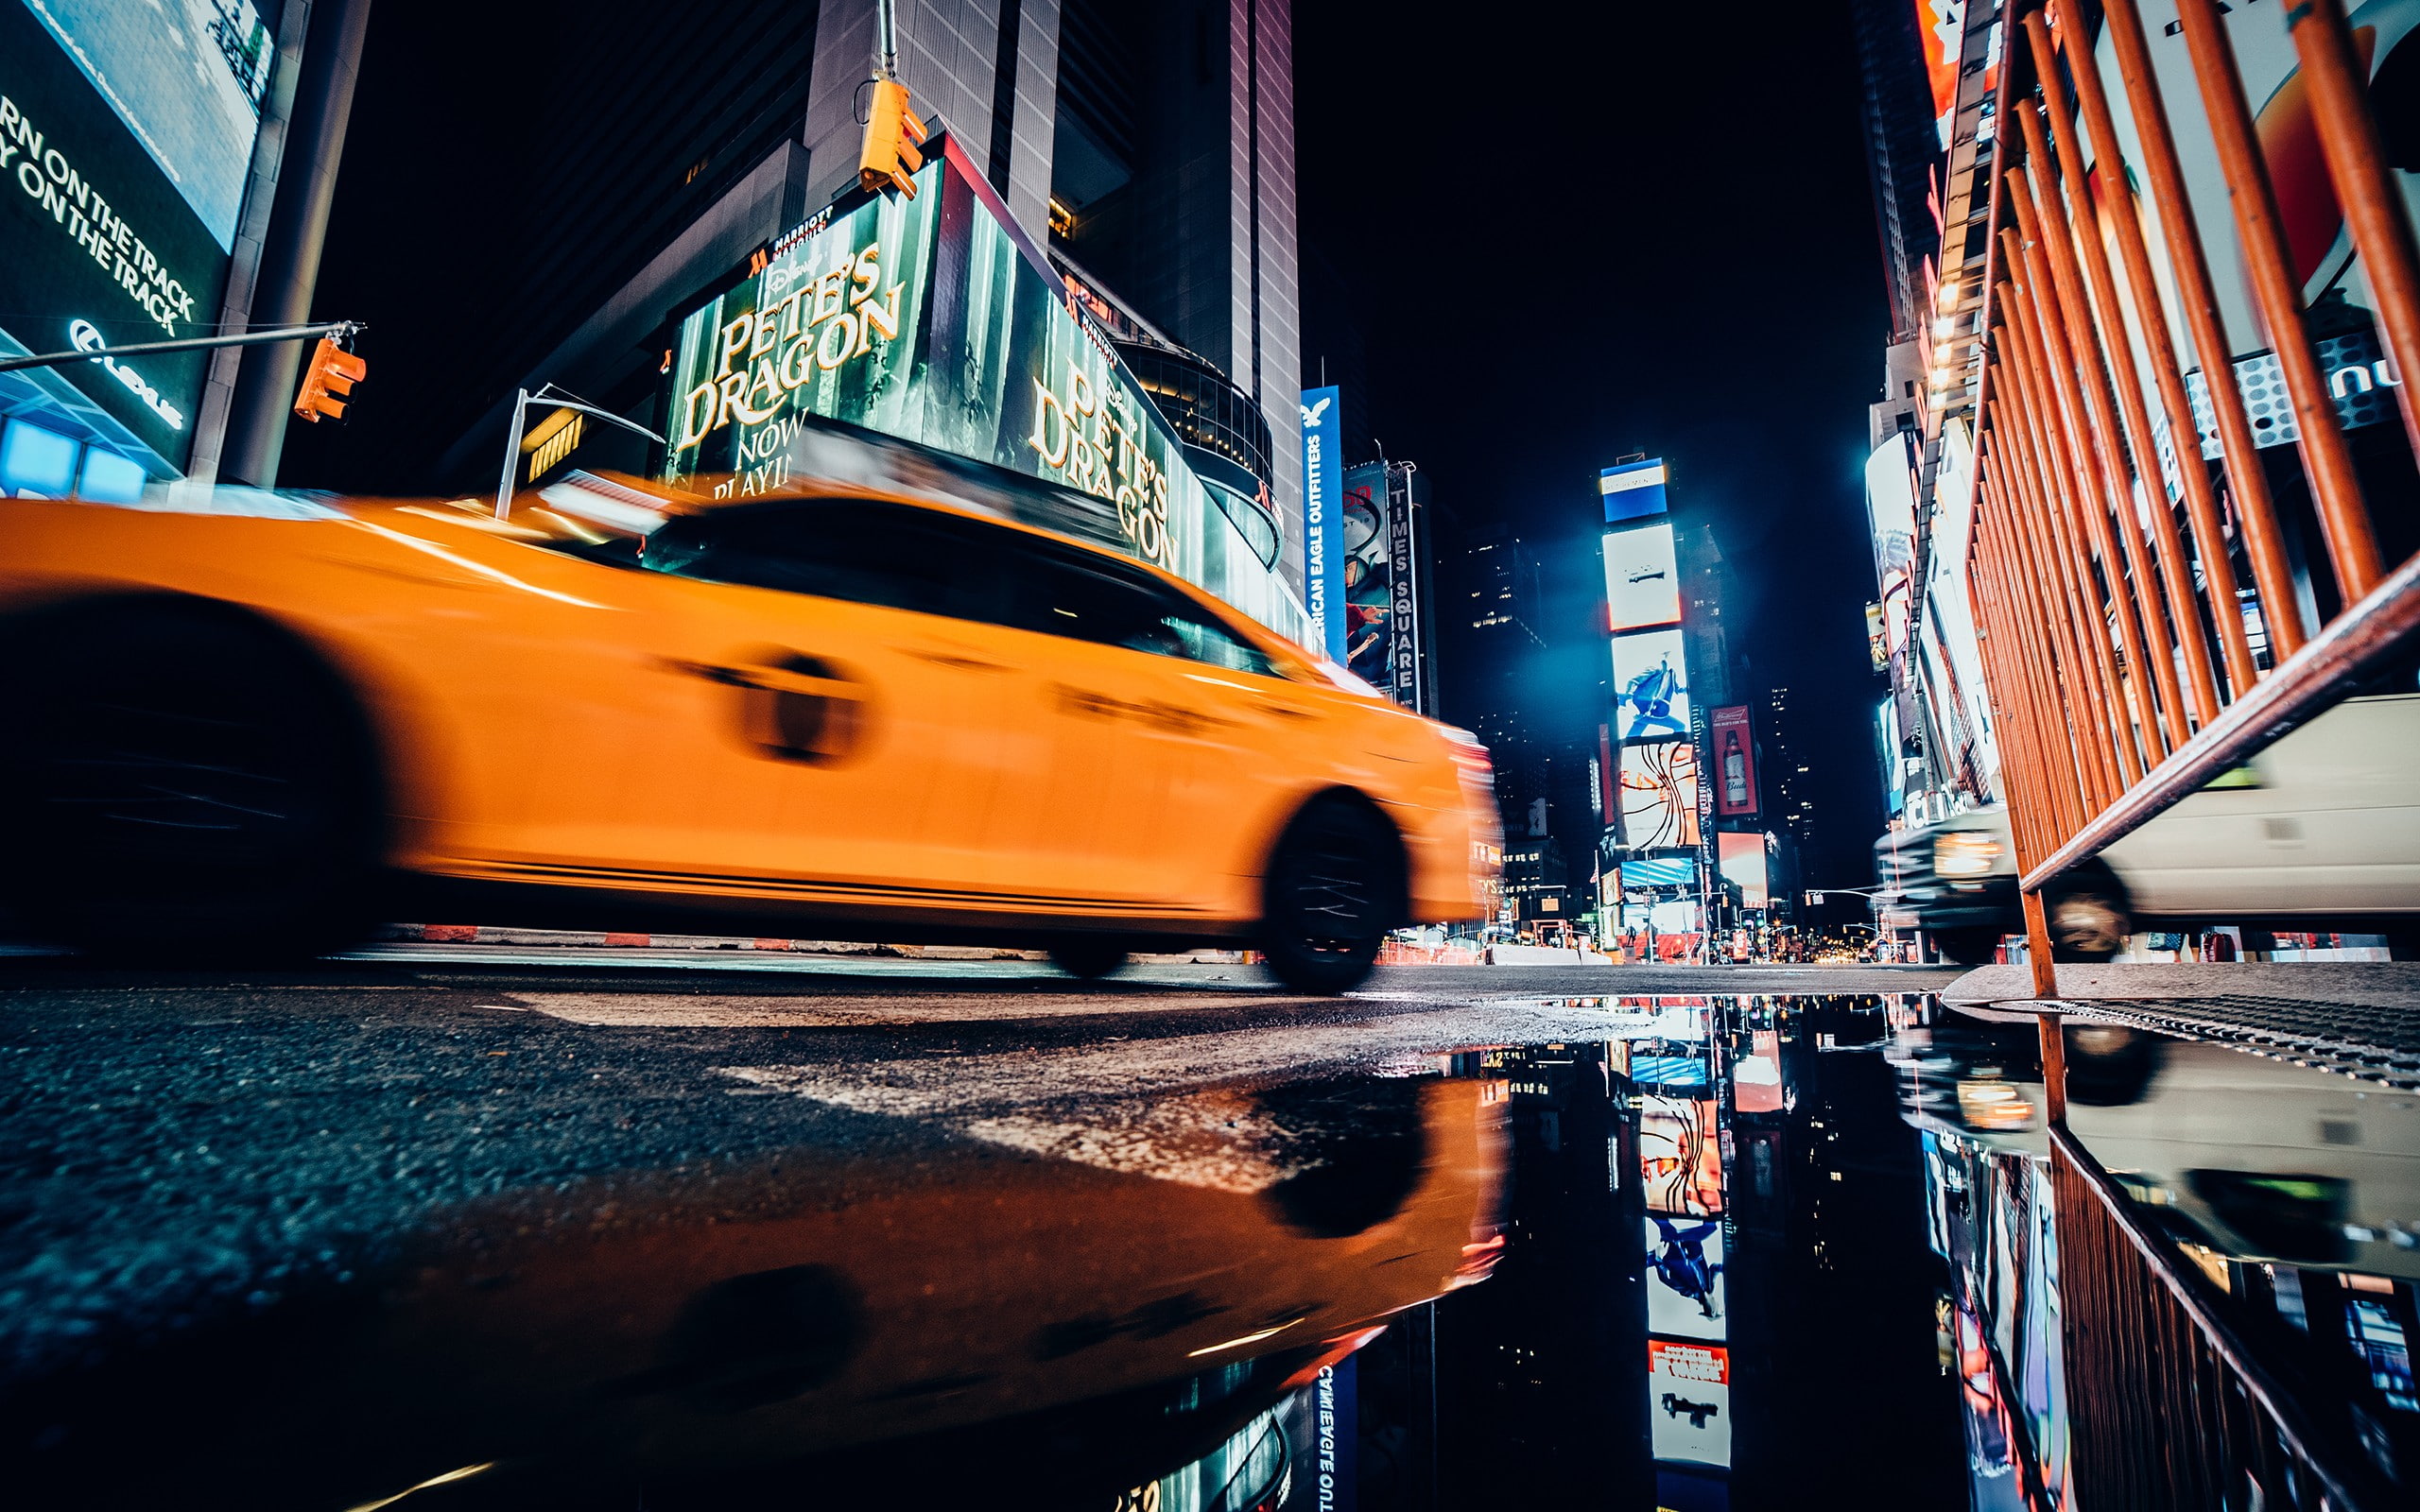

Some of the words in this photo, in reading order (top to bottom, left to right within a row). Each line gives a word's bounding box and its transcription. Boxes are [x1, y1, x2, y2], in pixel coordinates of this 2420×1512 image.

[0, 95, 44, 161] RN
[44, 148, 90, 210] ON
[91, 191, 134, 255] THE
[133, 237, 195, 322] TRACK
[18, 162, 67, 224] ON
[69, 204, 113, 270] THE
[114, 251, 178, 337] TRACK
[774, 204, 834, 252] MARRIOTT
[714, 242, 880, 384] PETE'S
[676, 281, 906, 453] DRAGON
[714, 453, 792, 501] PLAYI
[735, 406, 810, 472] NOW
[1029, 376, 1179, 576] DRAGON
[1064, 356, 1168, 523] PETE'S
[1307, 434, 1322, 524] OUTFITTERS
[1309, 526, 1323, 576] EAGLE
[1391, 489, 1409, 572] TIMES
[1311, 579, 1324, 627] RICAN
[1395, 581, 1413, 688] SQUARE
